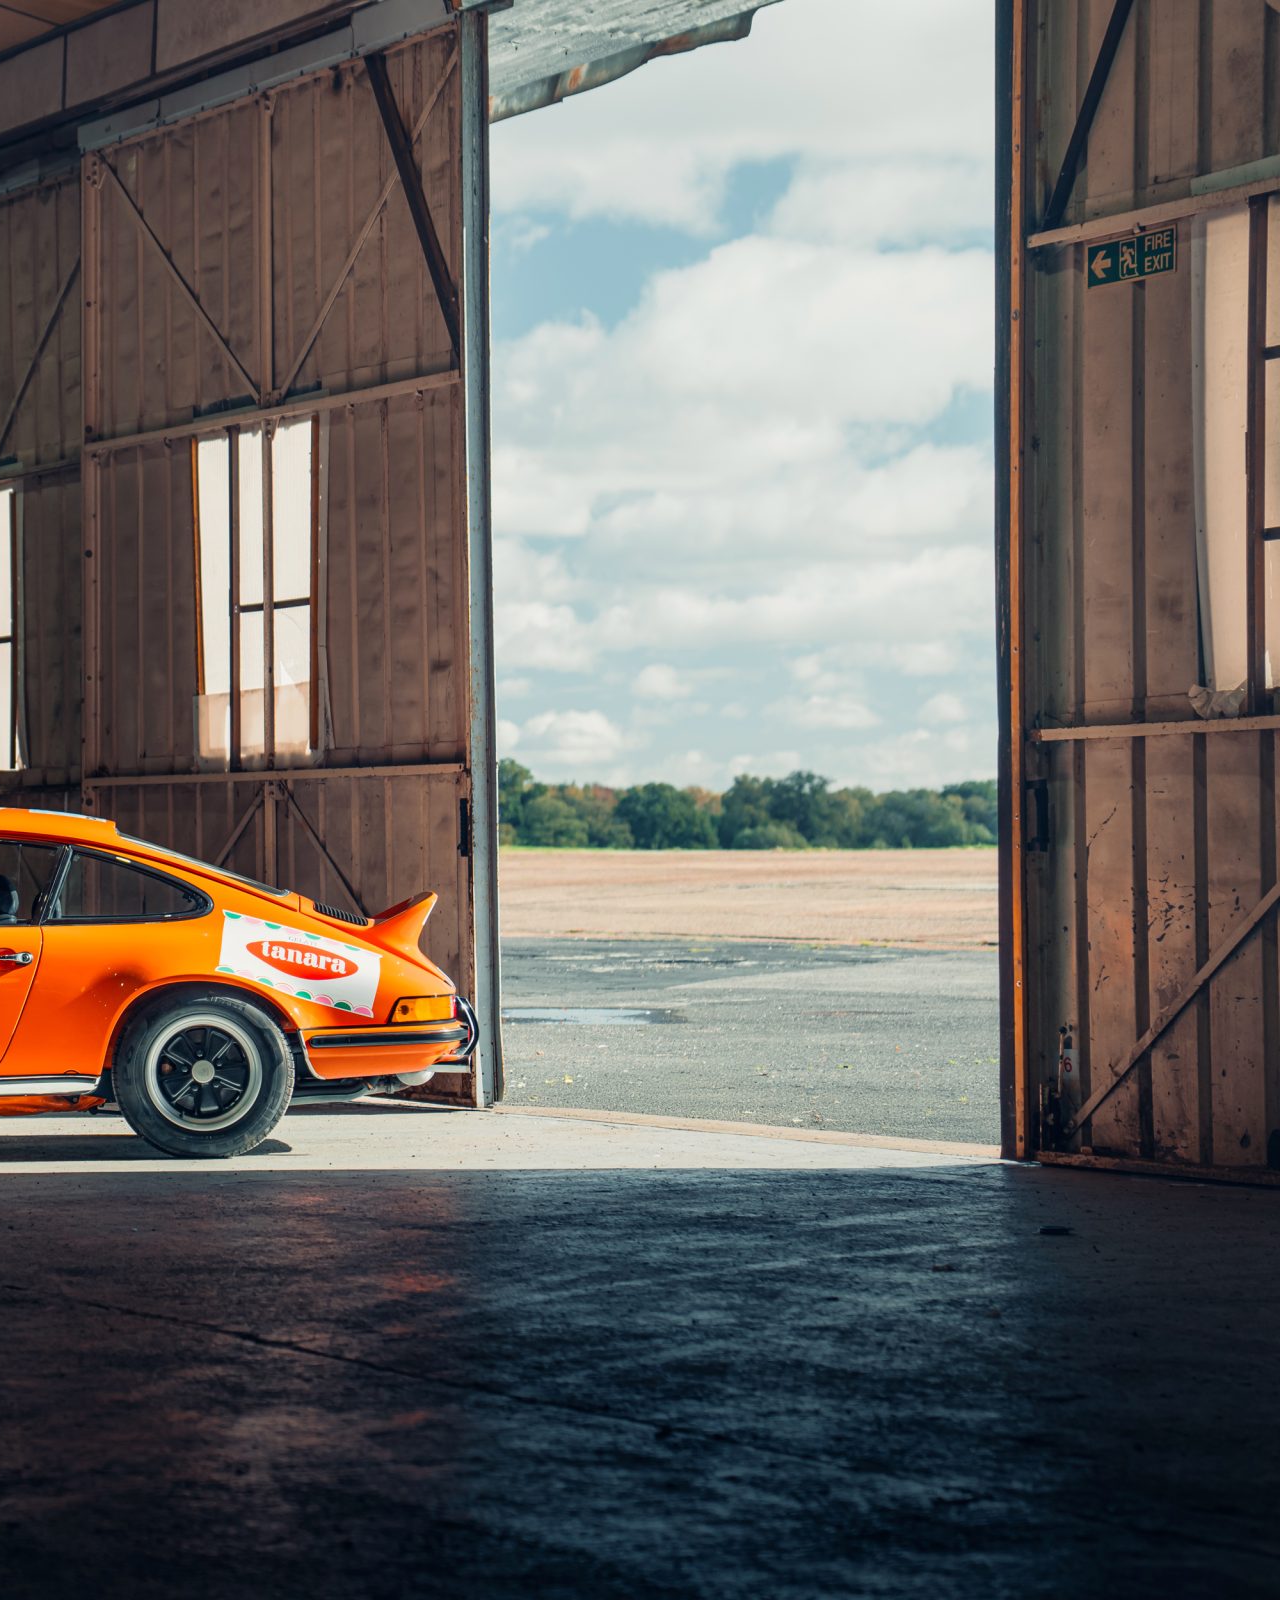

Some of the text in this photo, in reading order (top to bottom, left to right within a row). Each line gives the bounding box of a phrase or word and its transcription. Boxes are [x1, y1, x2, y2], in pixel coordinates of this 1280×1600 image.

[1144, 231, 1172, 252] FIRE
[1144, 252, 1172, 273] EXIT
[261, 940, 346, 974] tanara
